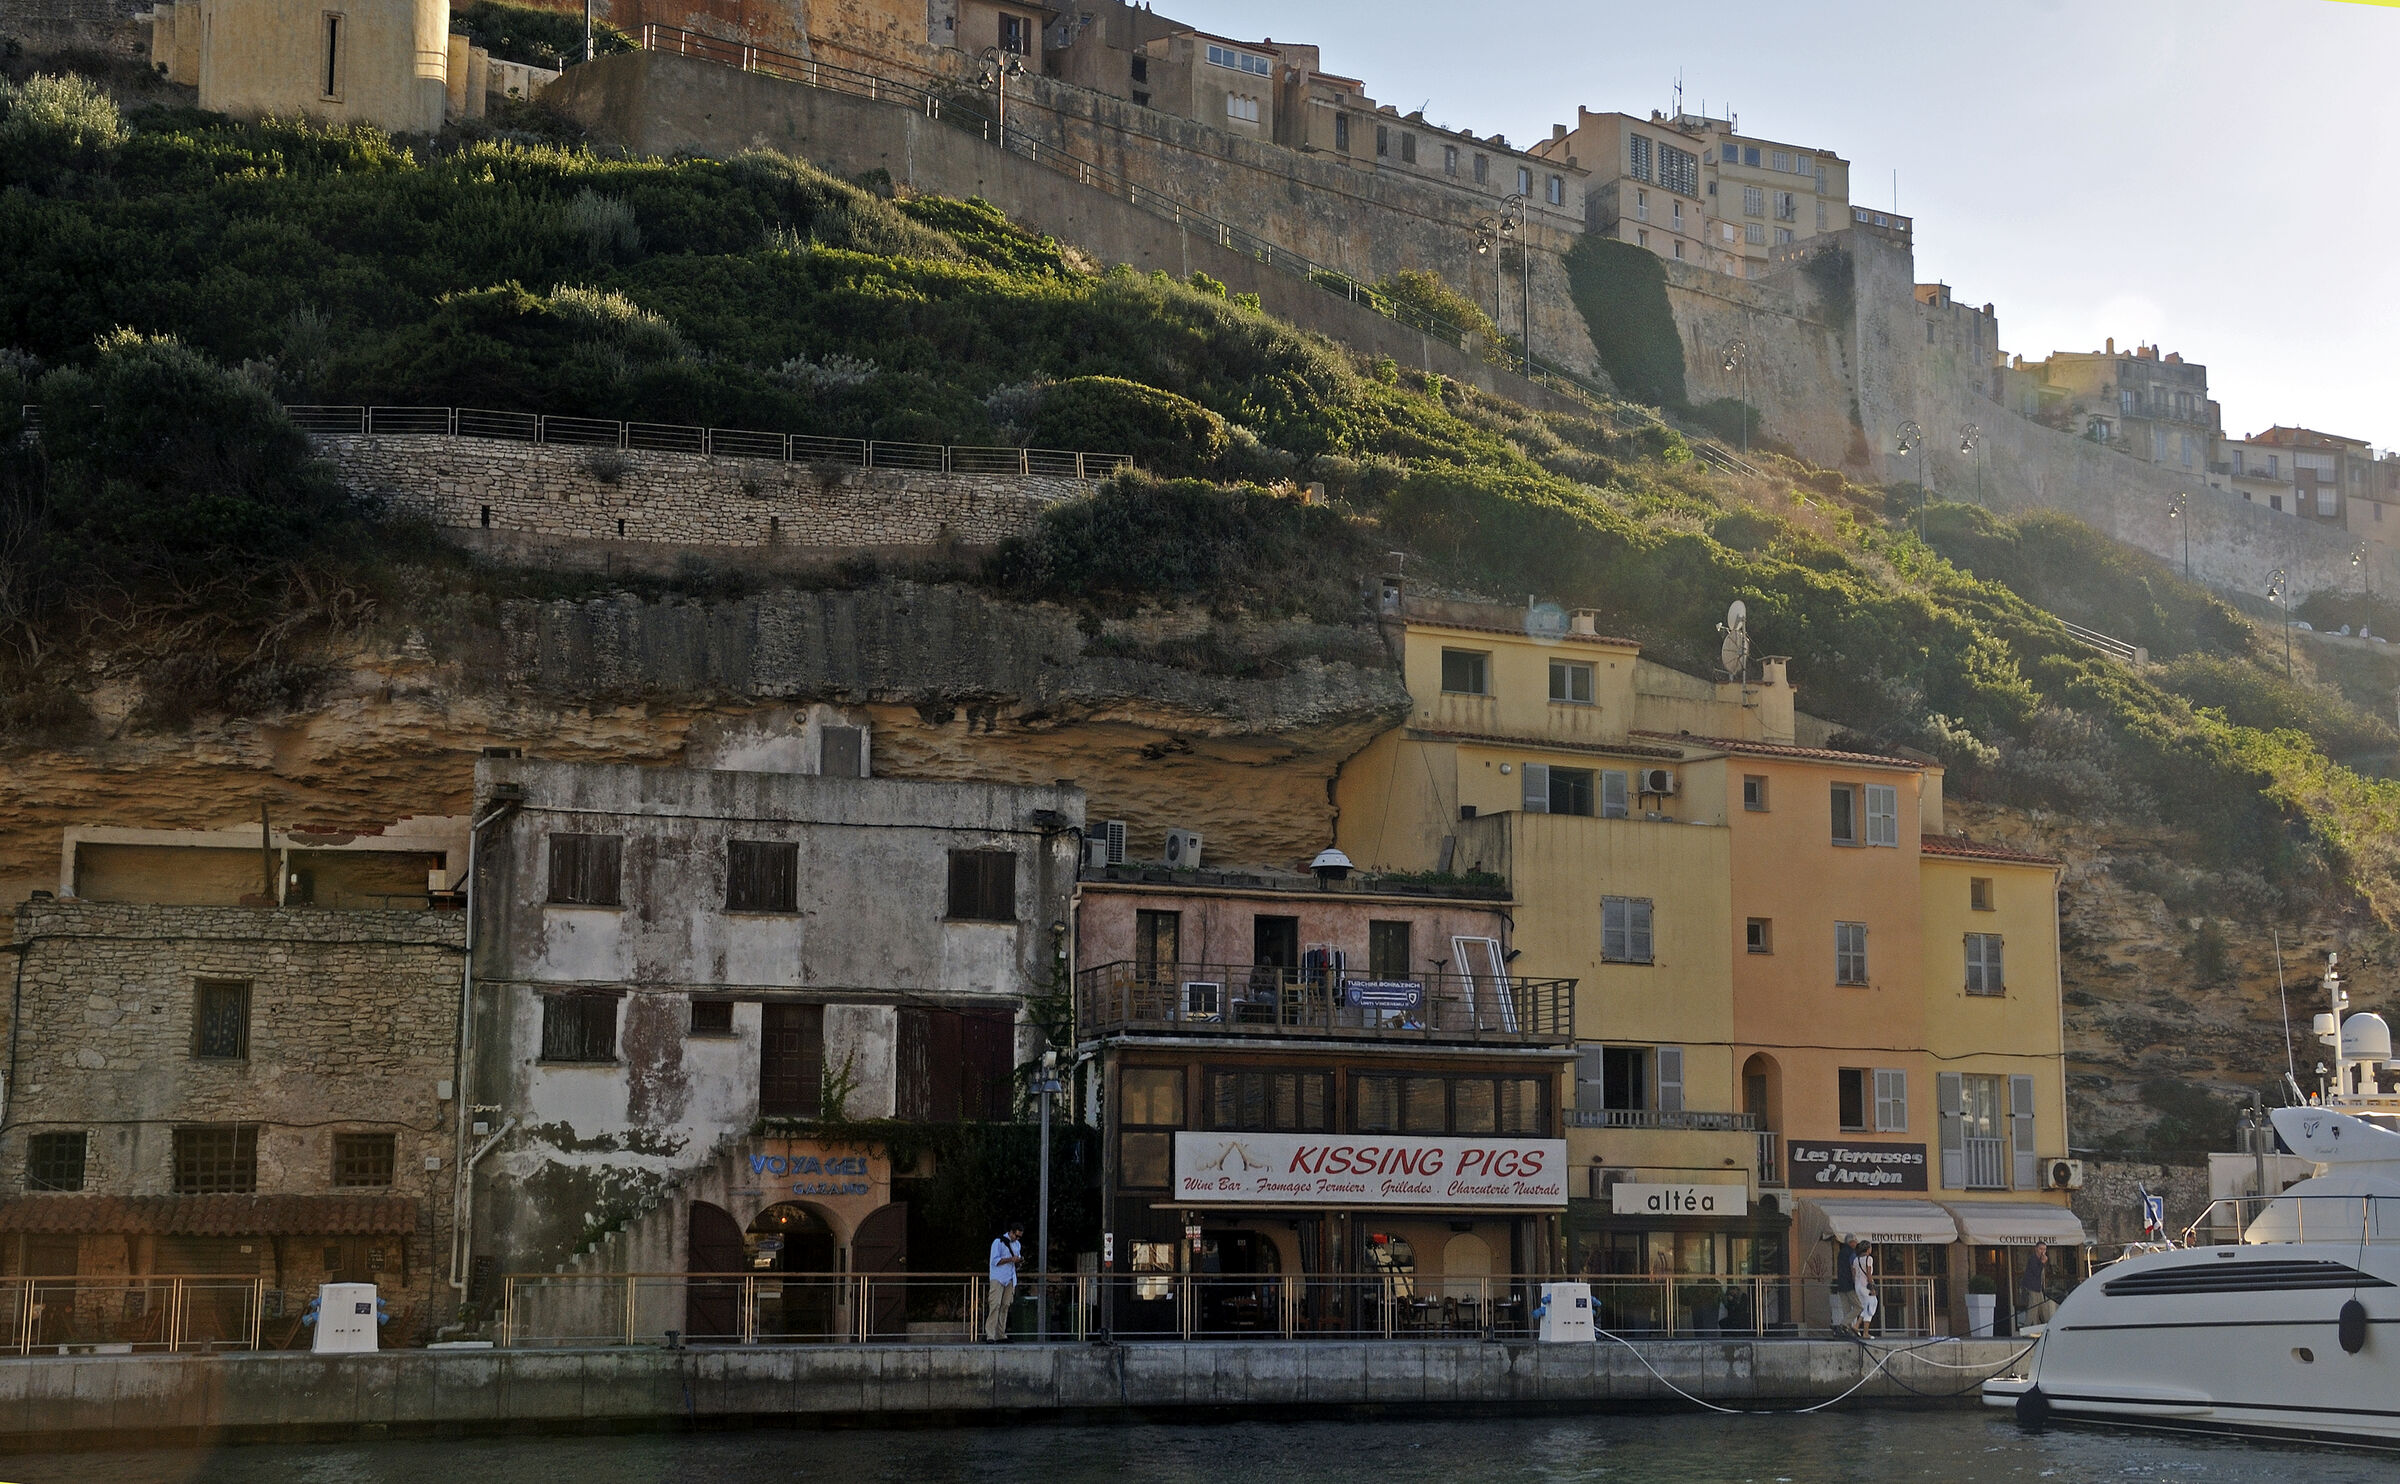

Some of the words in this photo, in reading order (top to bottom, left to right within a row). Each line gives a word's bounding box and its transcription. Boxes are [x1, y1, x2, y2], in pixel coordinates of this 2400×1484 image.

[749, 1154, 868, 1176] VOYAGES
[1288, 1145, 1444, 1177] KISSING
[1456, 1149, 1545, 1178] PIGS
[1793, 1147, 1829, 1162] Les
[1831, 1148, 1923, 1164] Terrasses
[1184, 1176, 1214, 1191] Wine
[1218, 1176, 1241, 1191] Bar
[1256, 1177, 1312, 1196] Fromages
[1315, 1178, 1366, 1194] Fermiers
[1380, 1179, 1432, 1197] Grillades
[1447, 1180, 1510, 1197] Charcuterie
[1512, 1181, 1561, 1196] Nustrale
[1647, 1188, 1714, 1211] altéa
[1871, 1233, 1923, 1243] BIJOUTERIE
[1999, 1235, 2057, 1244] COUTELLERIE
